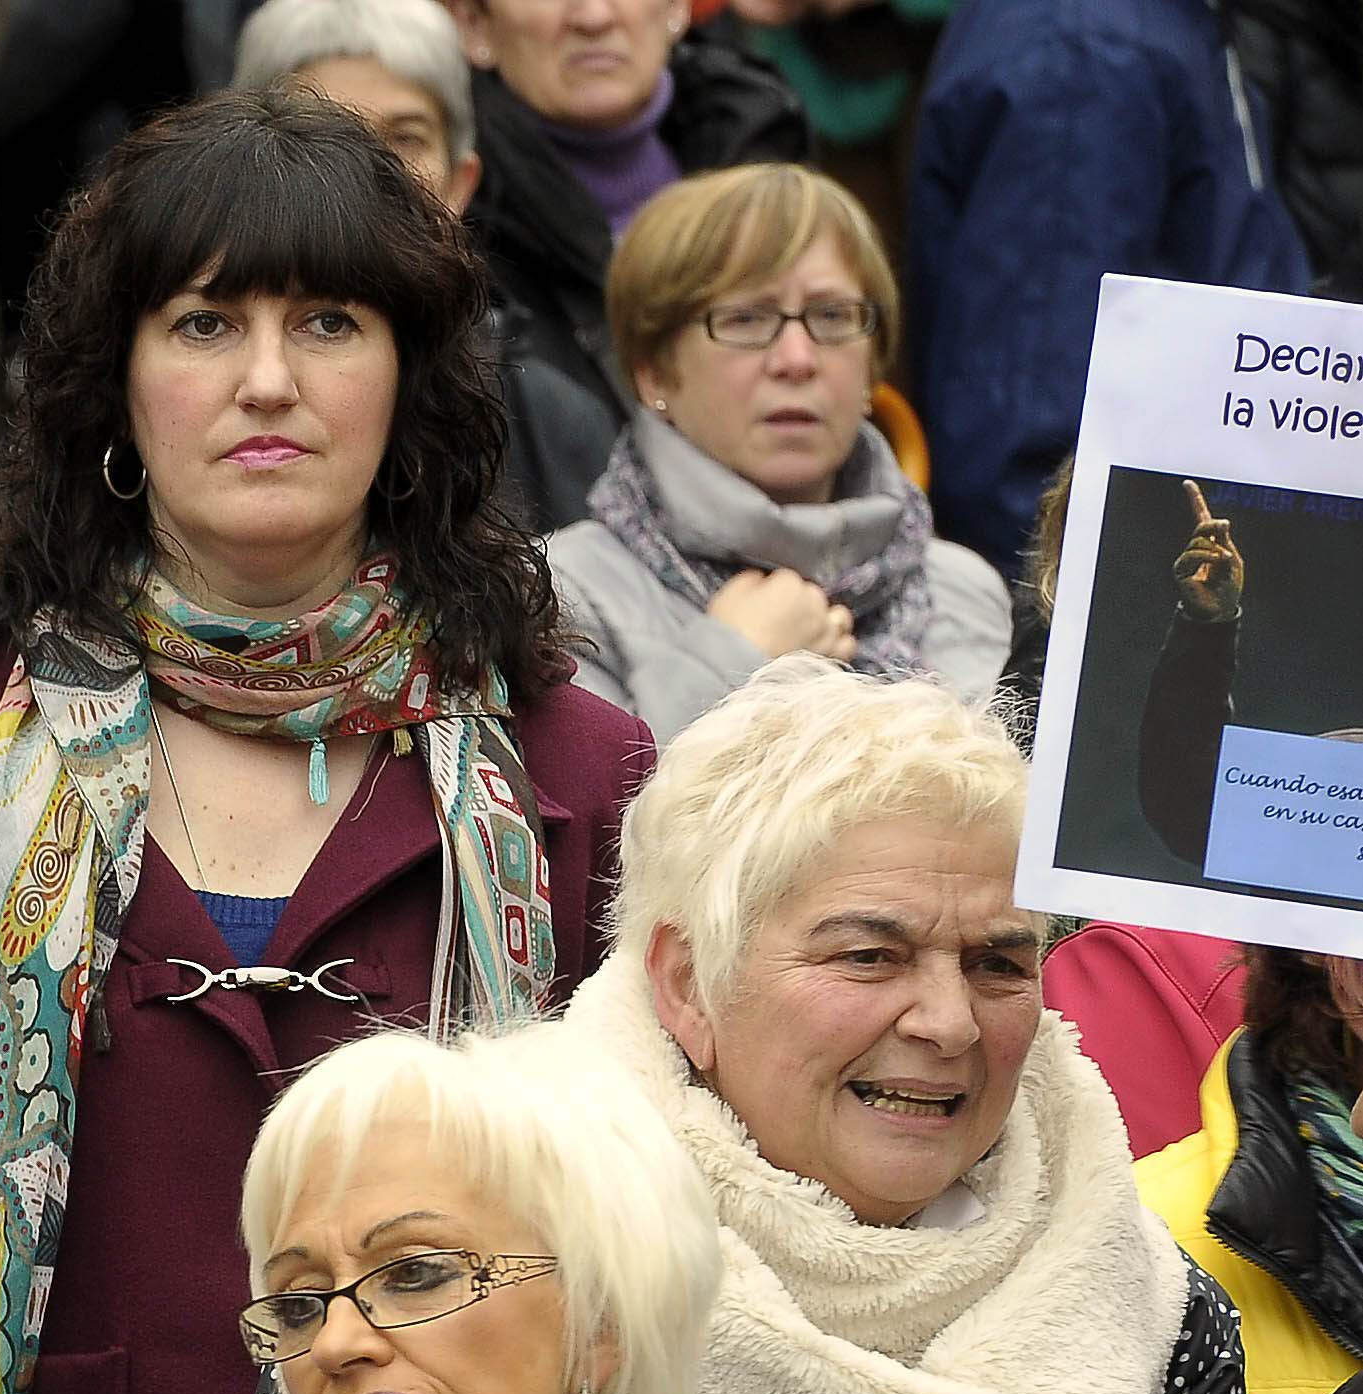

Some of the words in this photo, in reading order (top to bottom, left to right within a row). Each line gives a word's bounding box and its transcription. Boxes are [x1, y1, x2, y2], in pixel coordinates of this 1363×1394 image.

[1223, 391, 1254, 428] la
[1269, 397, 1363, 440] viole
[1225, 766, 1325, 795] Cuando
[1263, 804, 1297, 821] en
[1299, 809, 1330, 825] su
